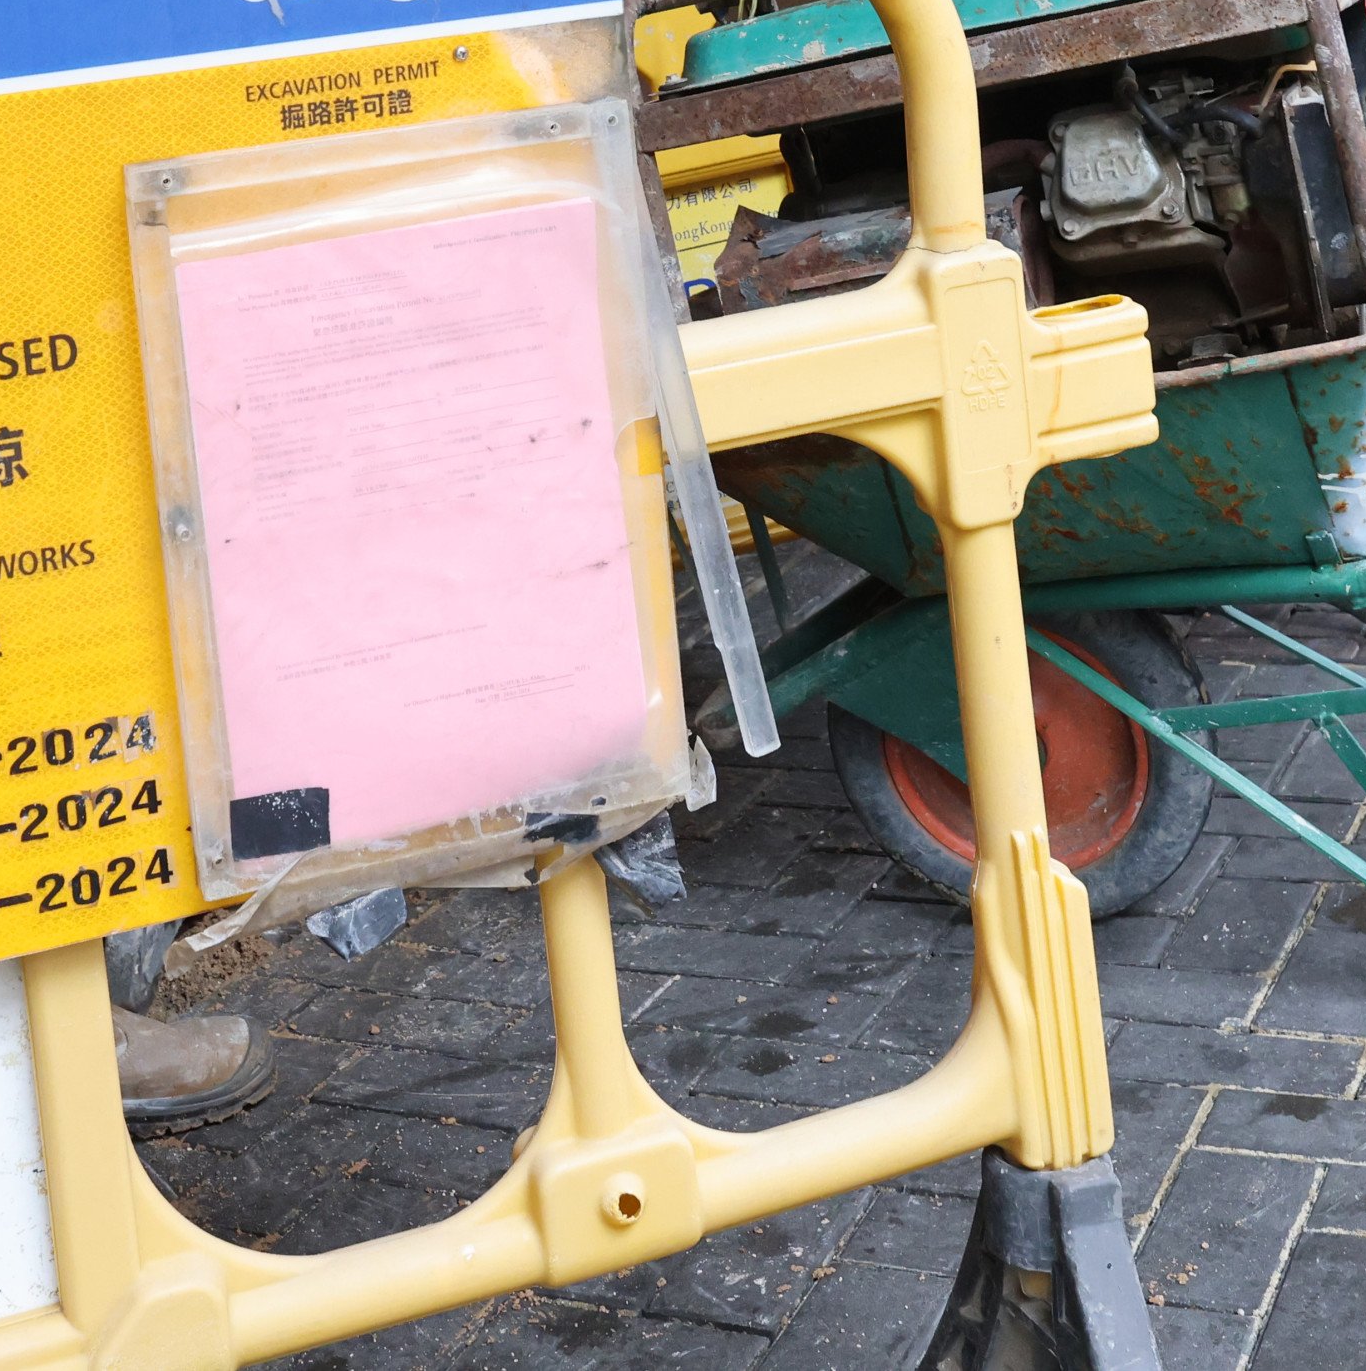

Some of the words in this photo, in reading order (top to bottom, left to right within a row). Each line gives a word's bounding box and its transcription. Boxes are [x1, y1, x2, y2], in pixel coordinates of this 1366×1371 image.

[246, 71, 362, 102] EXCAVATION
[373, 60, 439, 86] PERMIT
[280, 89, 413, 130] 掘路許可證
[675, 220, 735, 241] ongKong
